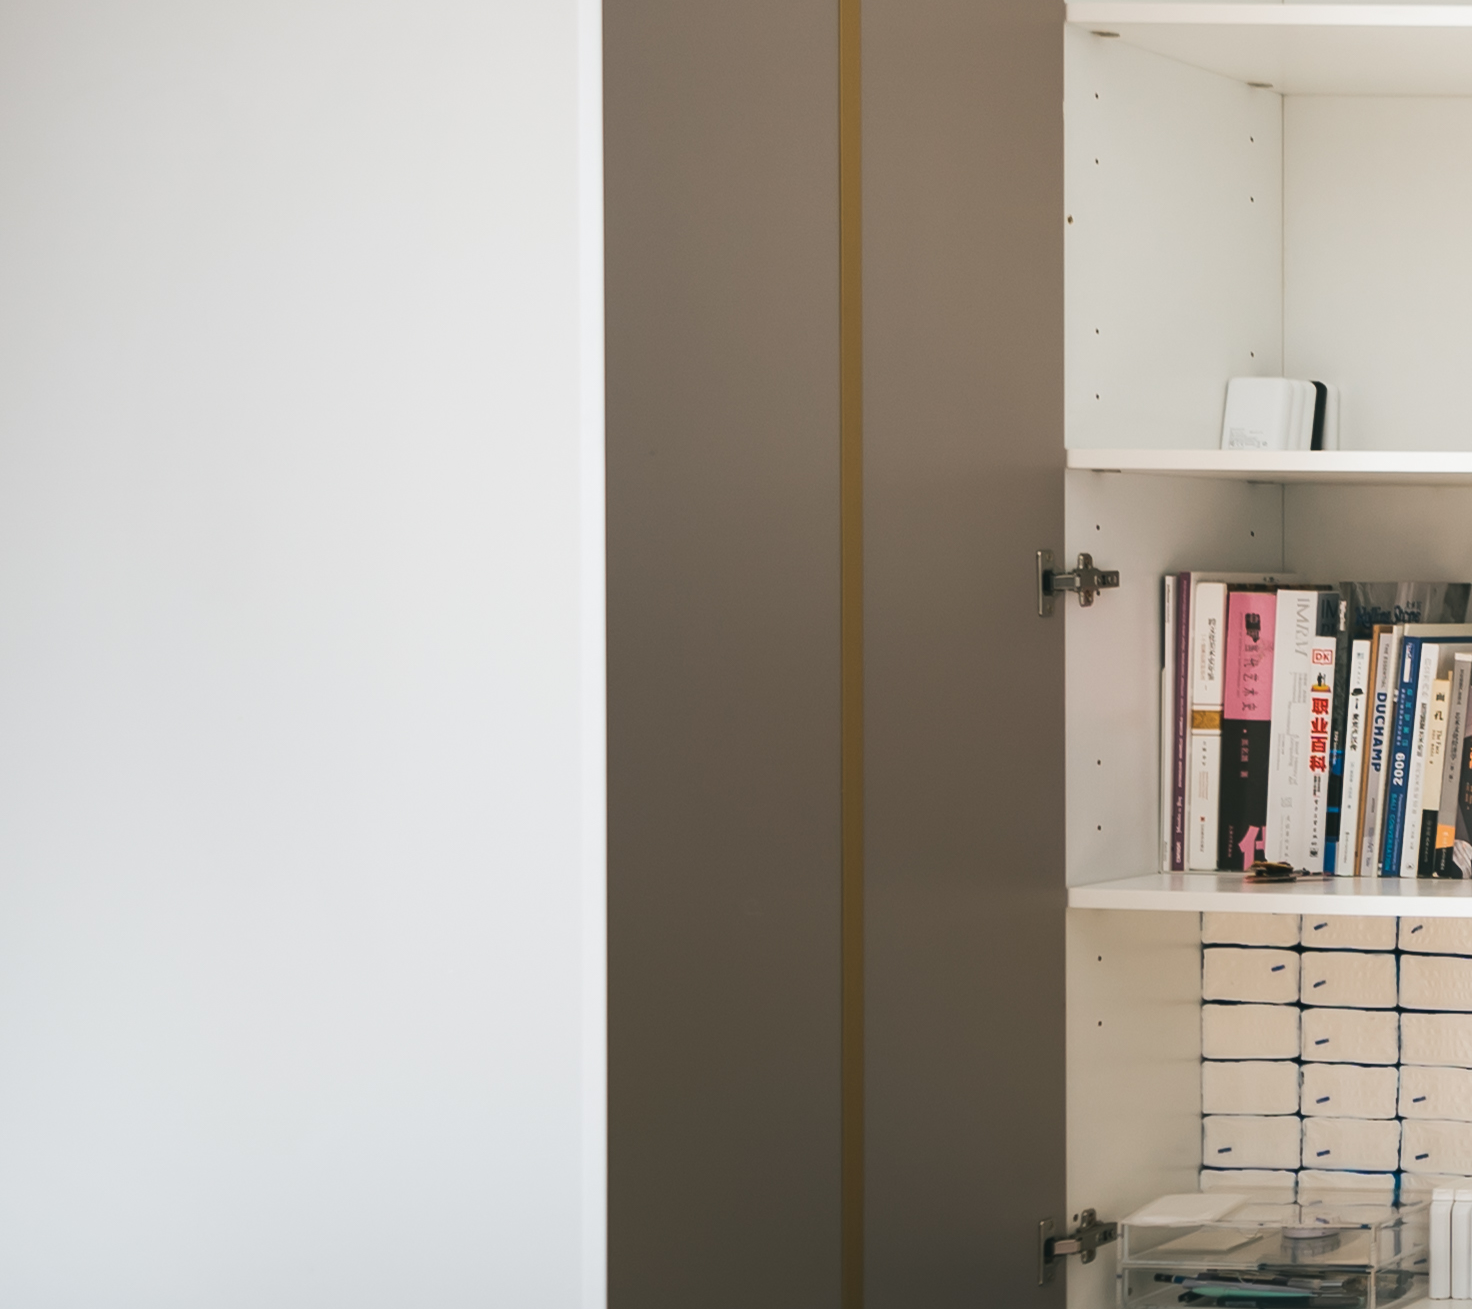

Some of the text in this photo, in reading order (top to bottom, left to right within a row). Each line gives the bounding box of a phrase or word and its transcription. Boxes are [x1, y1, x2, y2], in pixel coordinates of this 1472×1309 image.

[1314, 652, 1331, 663] DK
[1309, 697, 1329, 773] 职业百科
[1370, 692, 1388, 772] DUCHAMP
[1392, 752, 1405, 786] 2009
